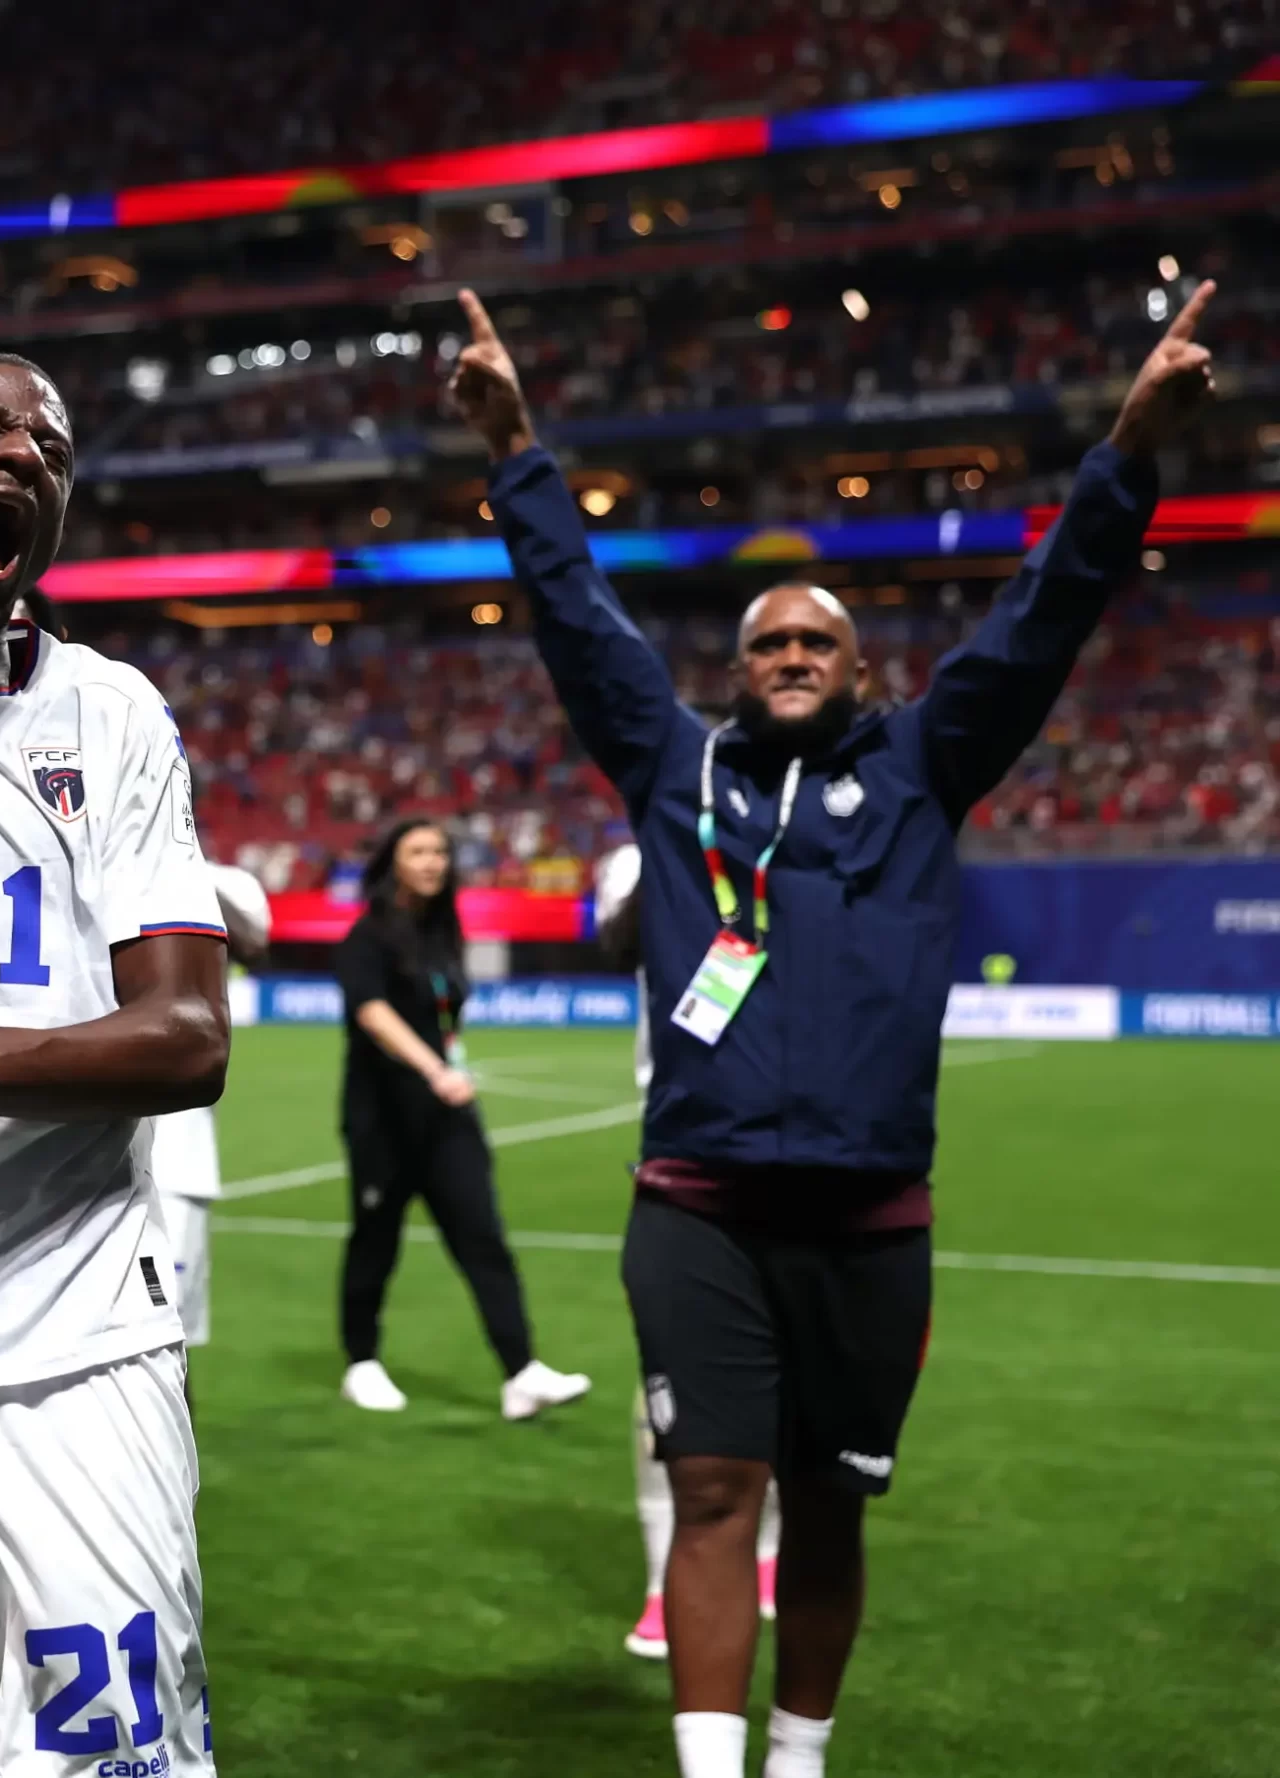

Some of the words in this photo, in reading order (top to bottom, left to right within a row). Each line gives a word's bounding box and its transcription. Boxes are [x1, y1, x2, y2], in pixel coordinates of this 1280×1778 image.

[28, 750, 79, 763] FCF
[24, 1610, 164, 1756] 21
[97, 1742, 171, 1778] capelli
